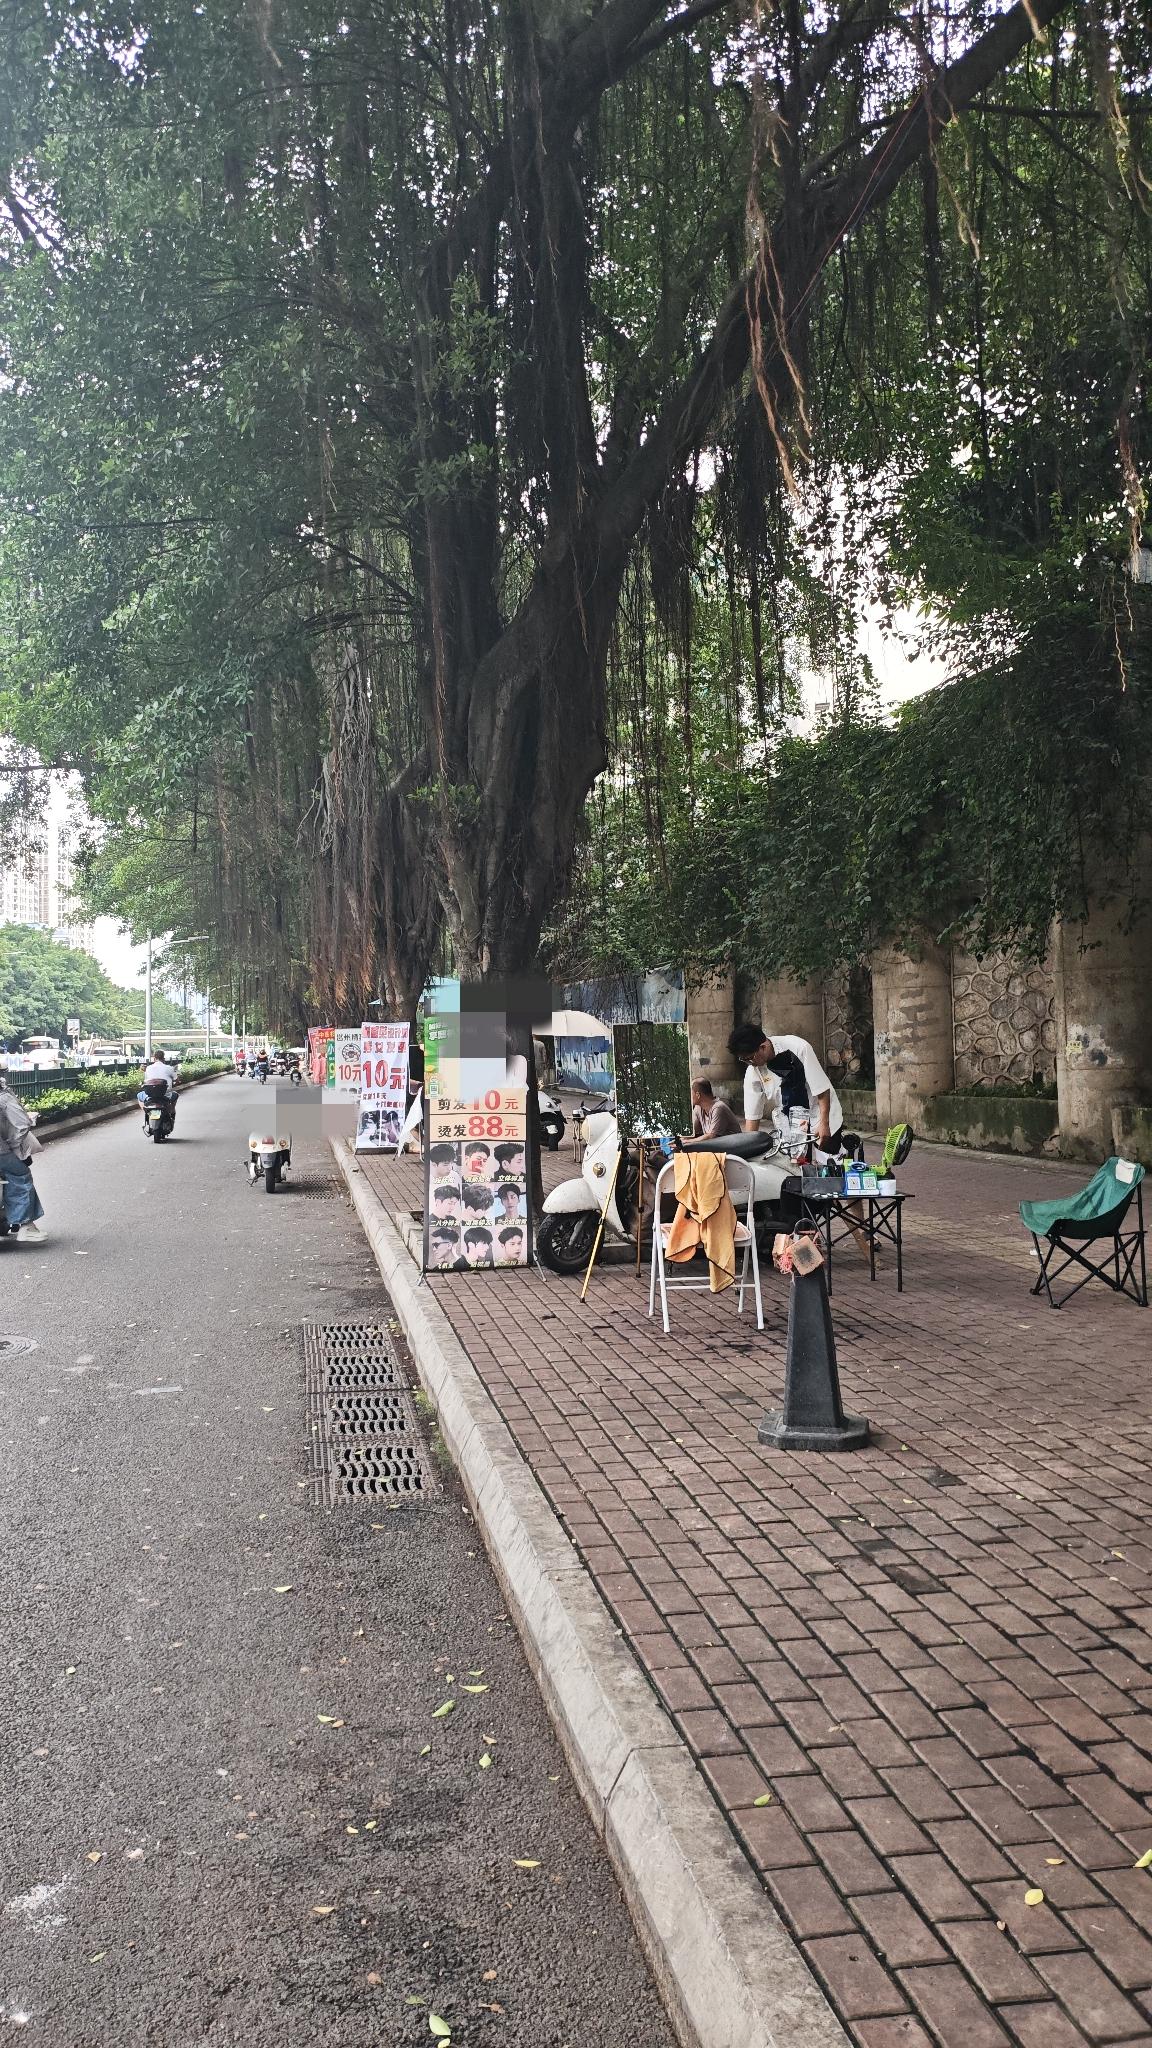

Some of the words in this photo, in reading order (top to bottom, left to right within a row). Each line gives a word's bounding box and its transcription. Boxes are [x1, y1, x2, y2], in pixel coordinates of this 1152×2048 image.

[339, 1064, 361, 1082] 10元
[362, 1059, 406, 1090] 10元
[438, 1115, 518, 1138] 烫发88元
